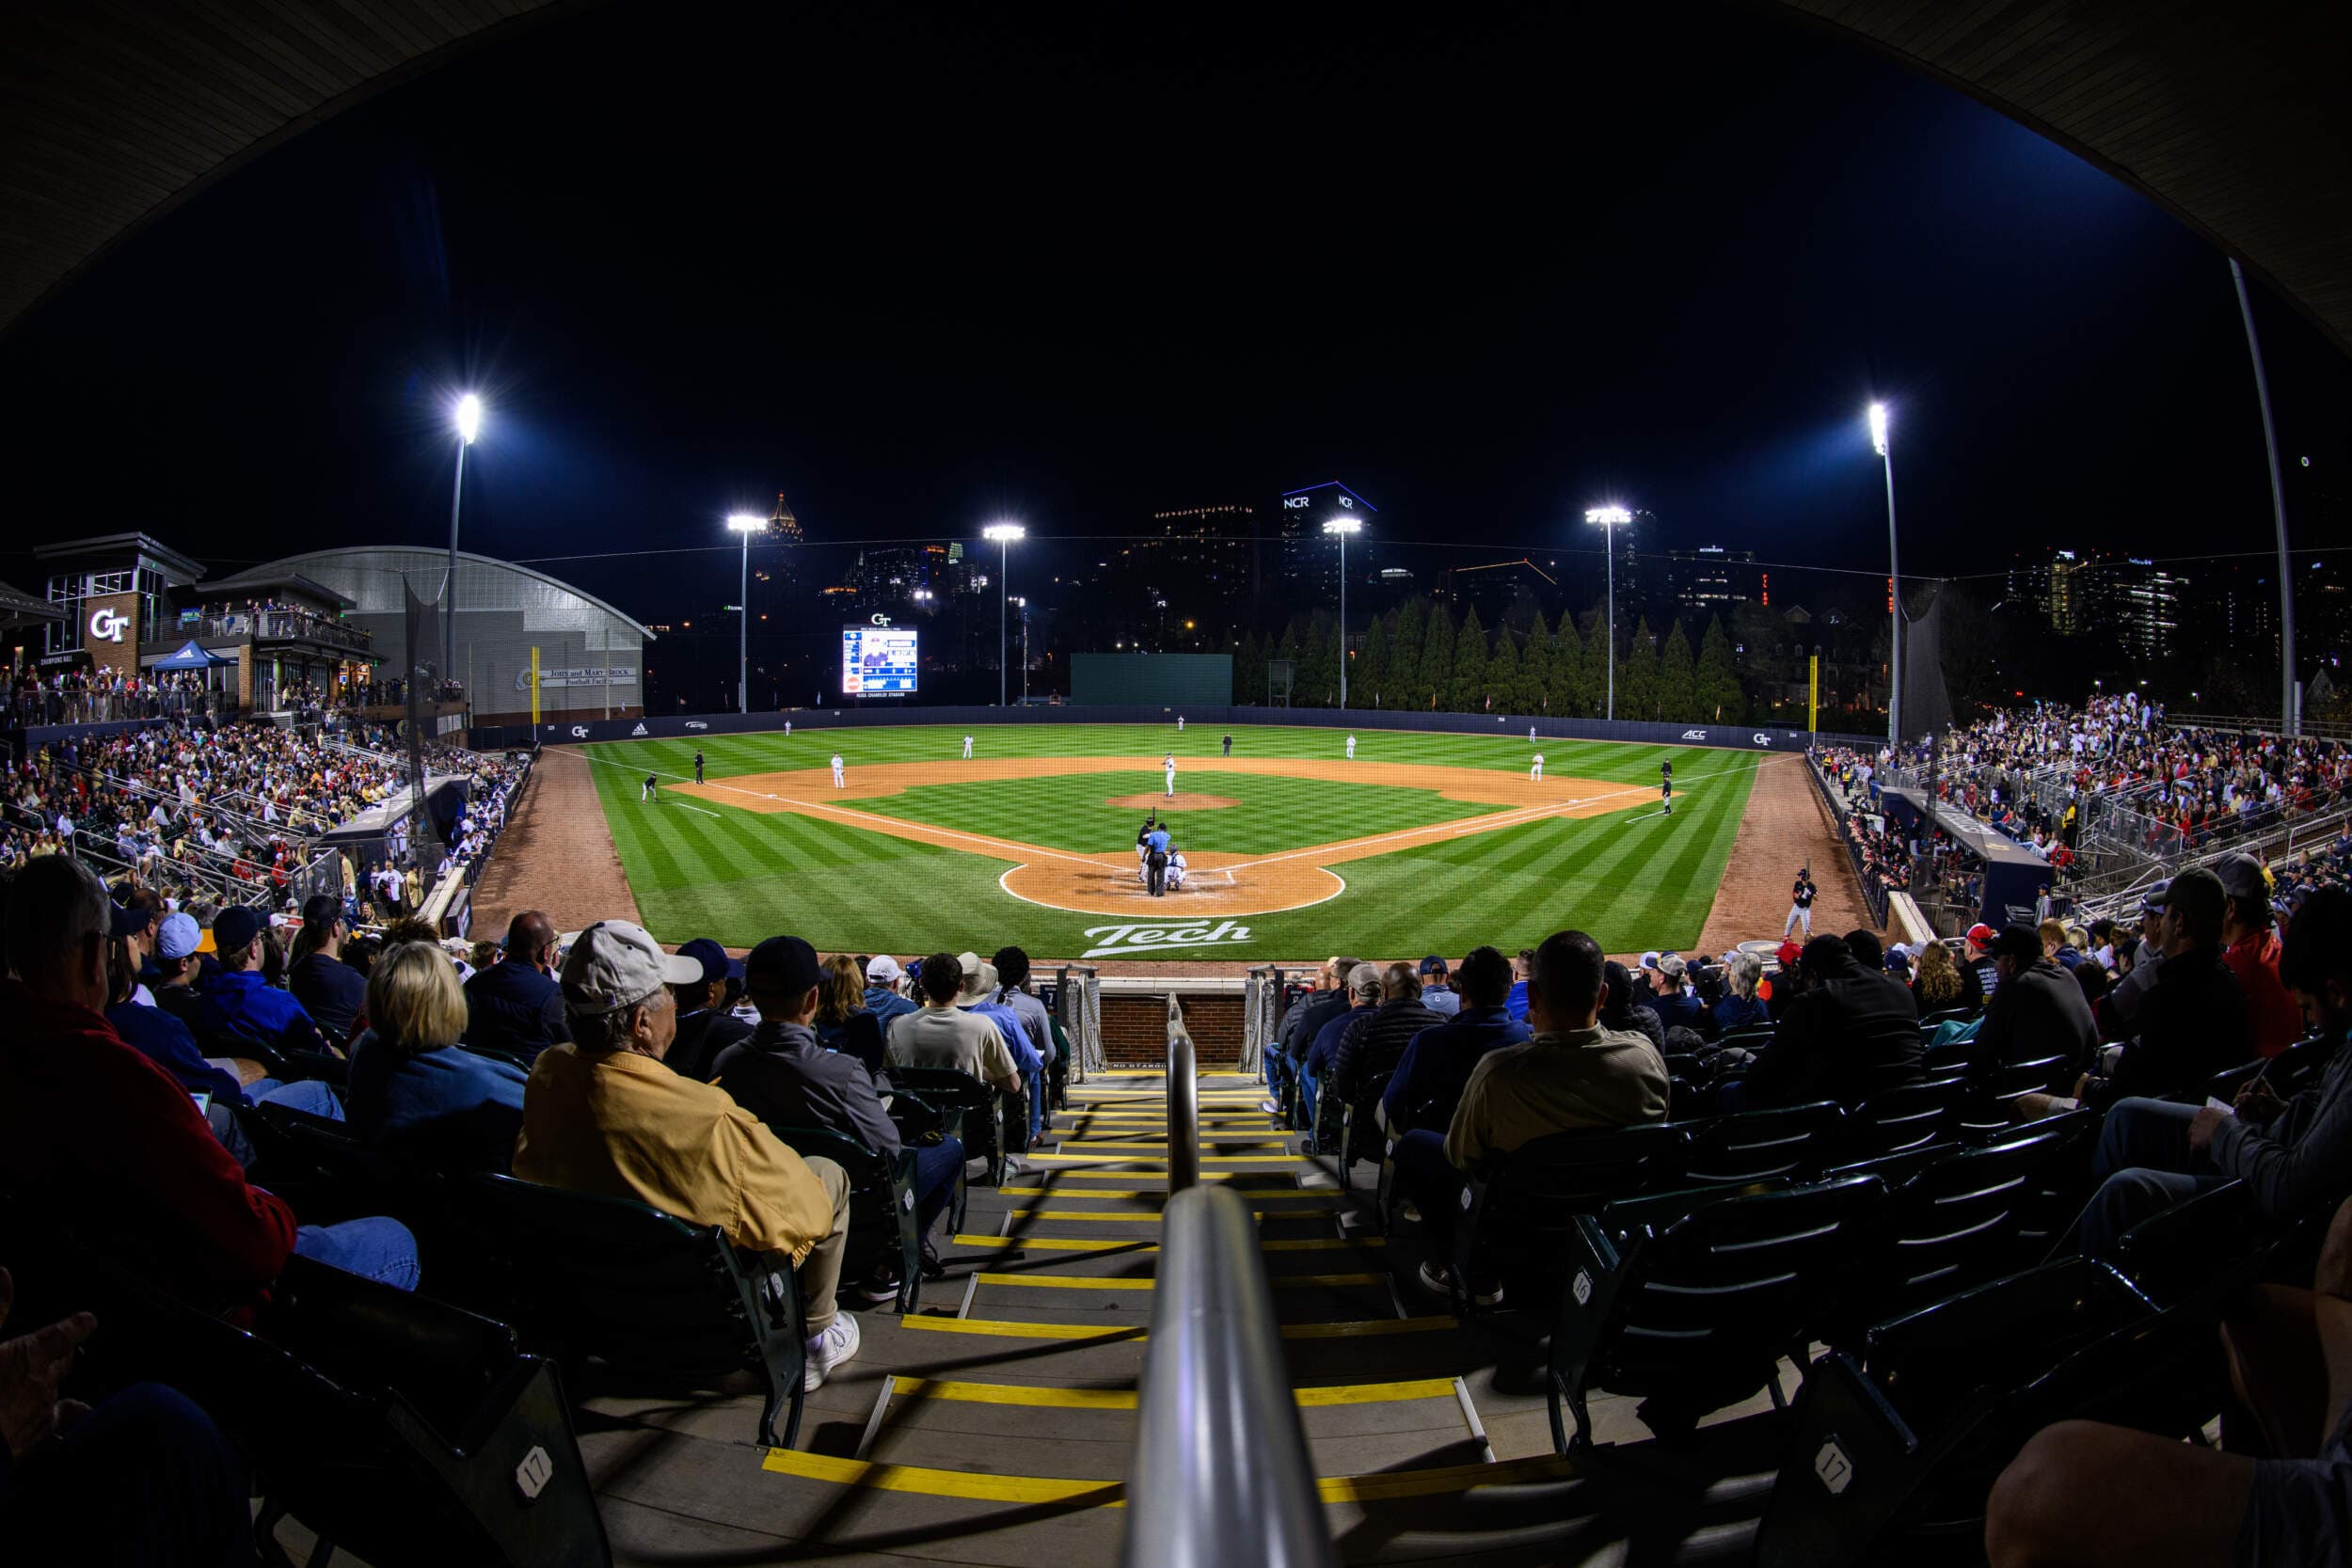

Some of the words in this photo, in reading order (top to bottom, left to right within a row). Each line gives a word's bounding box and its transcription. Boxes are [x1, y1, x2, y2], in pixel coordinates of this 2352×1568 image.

[1284, 496, 1310, 509] NCR
[1339, 495, 1353, 509] NCR
[90, 607, 130, 643] GT
[871, 613, 891, 627] GT
[571, 725, 589, 738] GT
[1681, 730, 1708, 738] ACC
[1753, 733, 1772, 746] GT
[1083, 920, 1253, 948] Tech
[1047, 992, 1054, 1004] 7
[1576, 1277, 1589, 1299] 16
[524, 1452, 545, 1489] 17
[1821, 1452, 1847, 1482] 17
